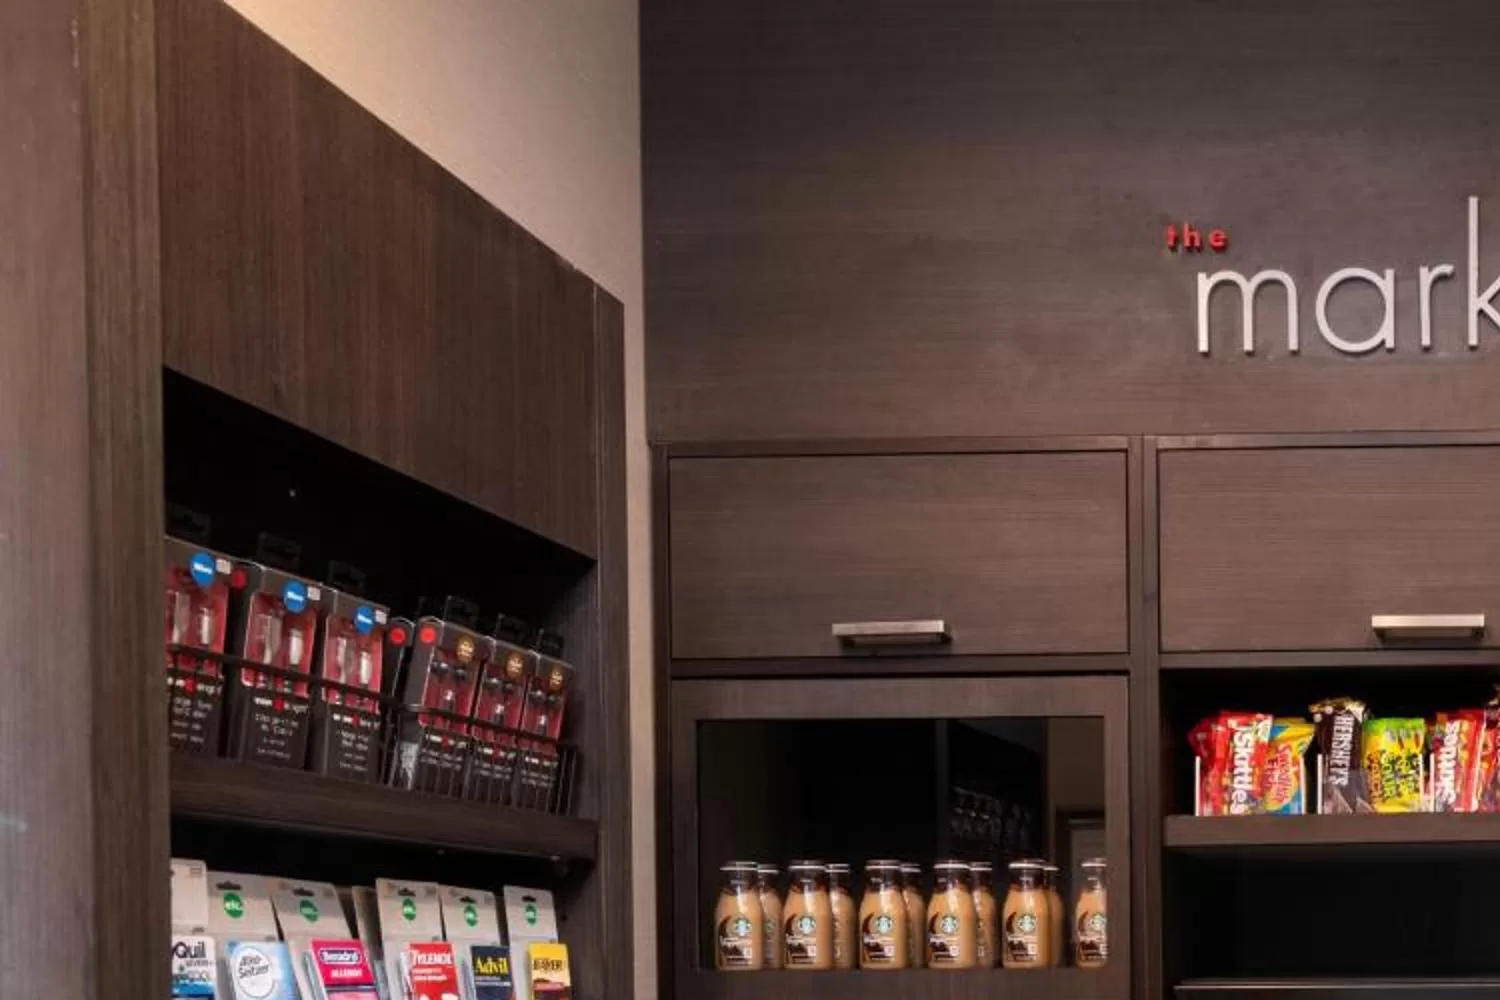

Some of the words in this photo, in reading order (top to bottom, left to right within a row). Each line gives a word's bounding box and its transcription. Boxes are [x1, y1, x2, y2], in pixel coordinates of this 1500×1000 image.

[1165, 224, 1229, 252] the
[1329, 714, 1355, 788] HERSHEY'S
[1230, 730, 1254, 814] Skittles
[173, 941, 207, 959] Quil
[238, 965, 270, 979] Seltzer
[475, 957, 508, 974] Advil
